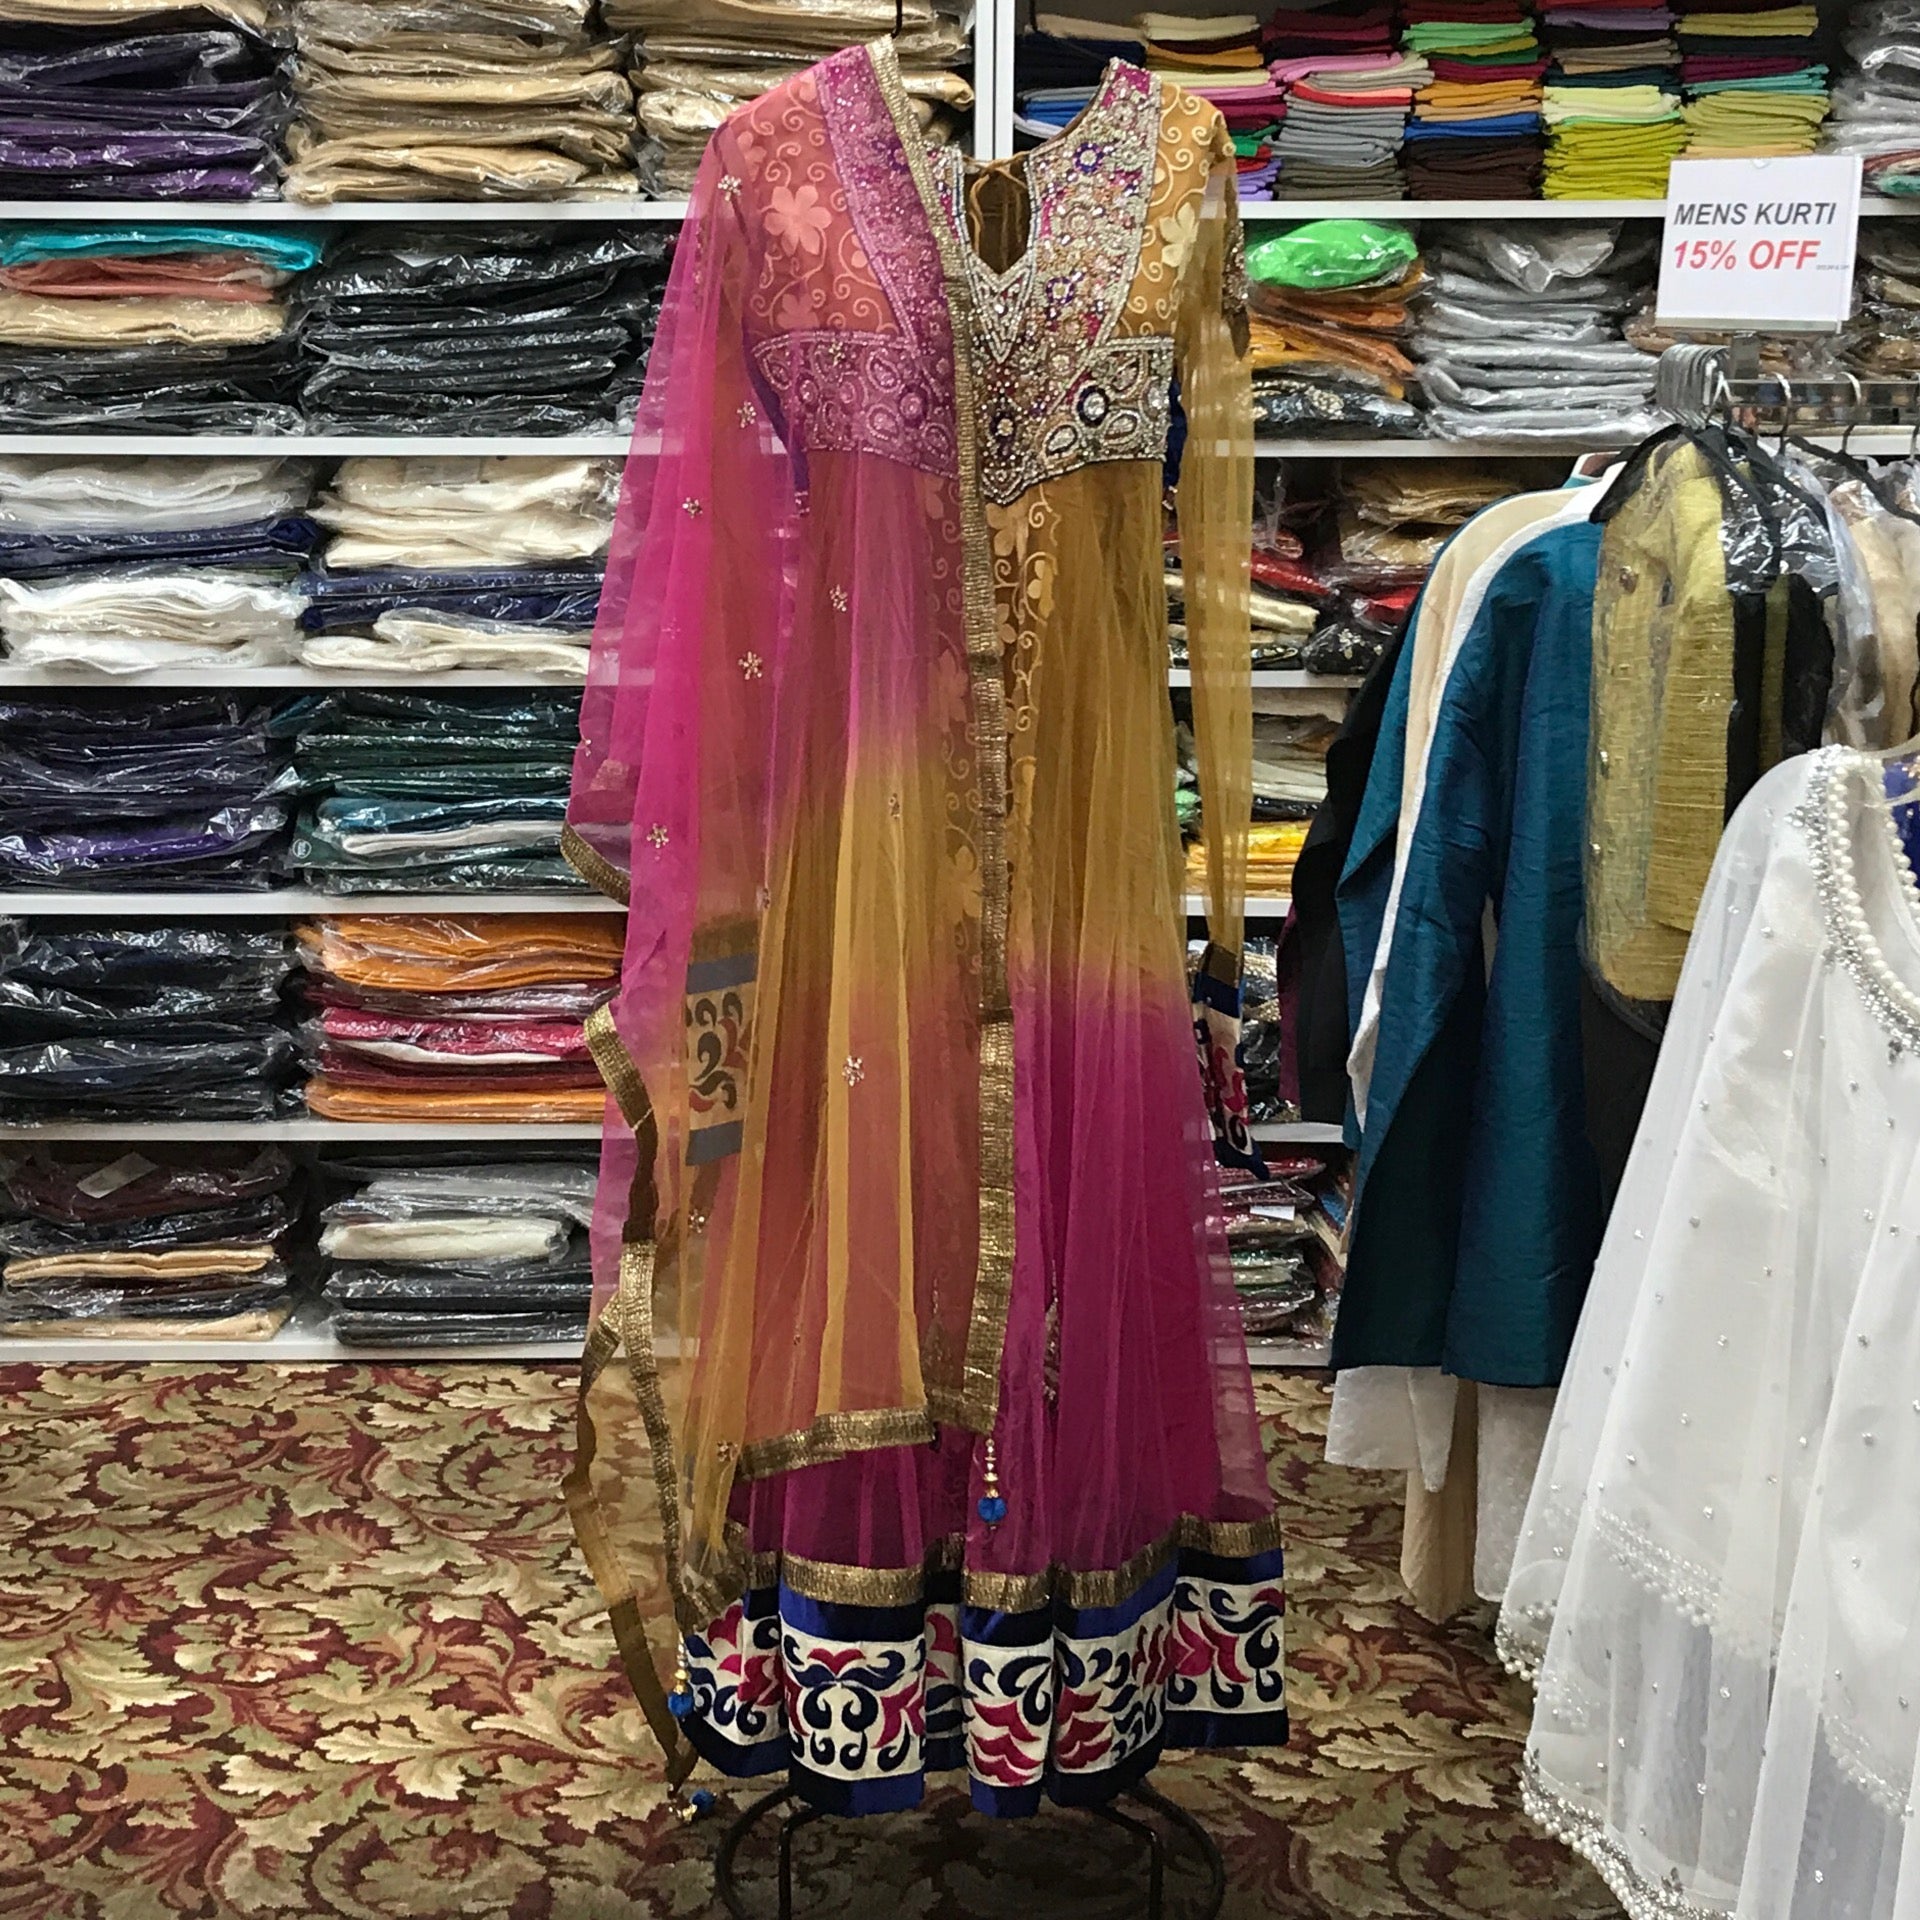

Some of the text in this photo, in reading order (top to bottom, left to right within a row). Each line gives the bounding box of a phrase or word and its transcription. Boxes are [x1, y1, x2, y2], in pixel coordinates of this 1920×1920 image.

[1674, 203, 1836, 225] MENS KURTI
[1675, 240, 1820, 270] 15% OFF
